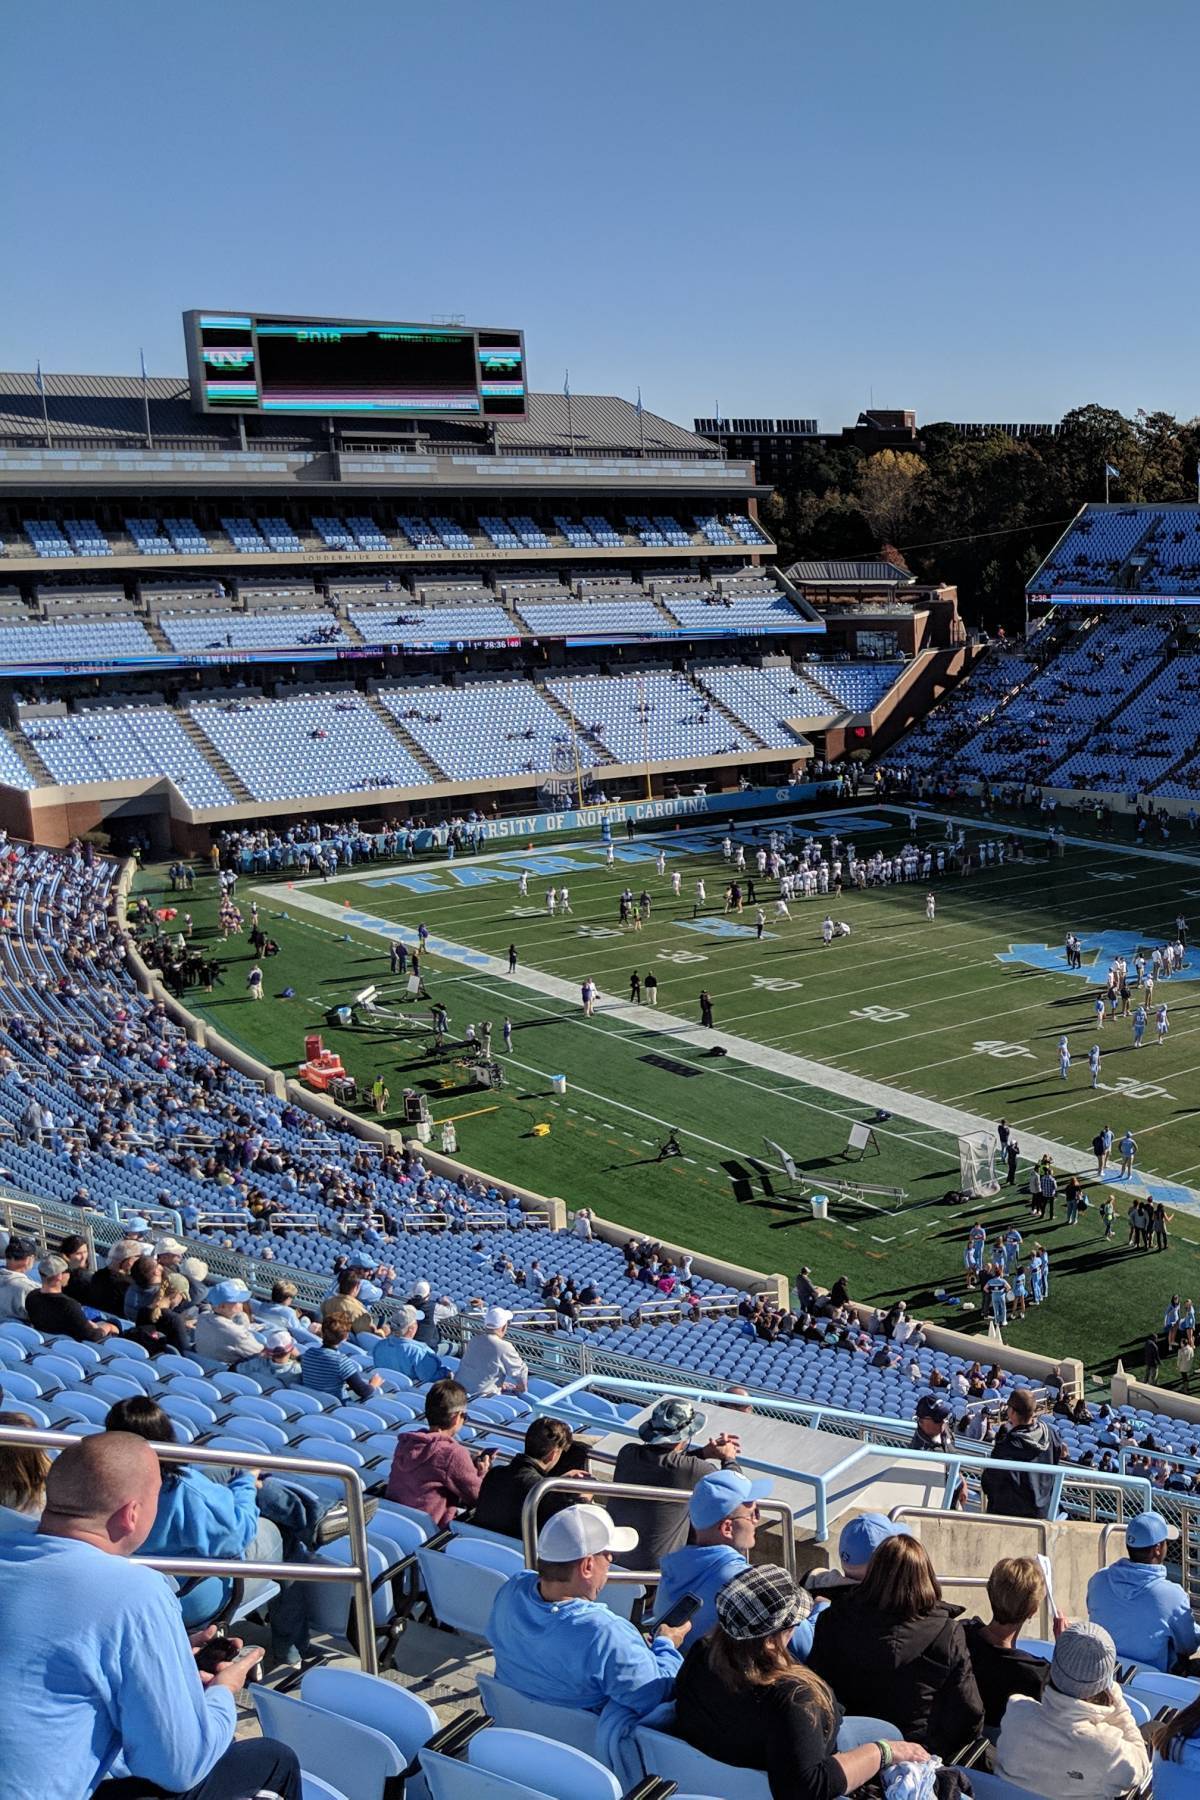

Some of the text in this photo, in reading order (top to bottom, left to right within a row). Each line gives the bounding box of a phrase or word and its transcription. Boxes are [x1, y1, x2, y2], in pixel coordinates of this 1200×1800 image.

[546, 814, 565, 831] OF
[636, 796, 710, 821] CAROLINA
[360, 855, 608, 894] TAR
[849, 1005, 910, 1022] 50
[972, 1040, 1032, 1058] 40
[1096, 1077, 1167, 1099] 30
